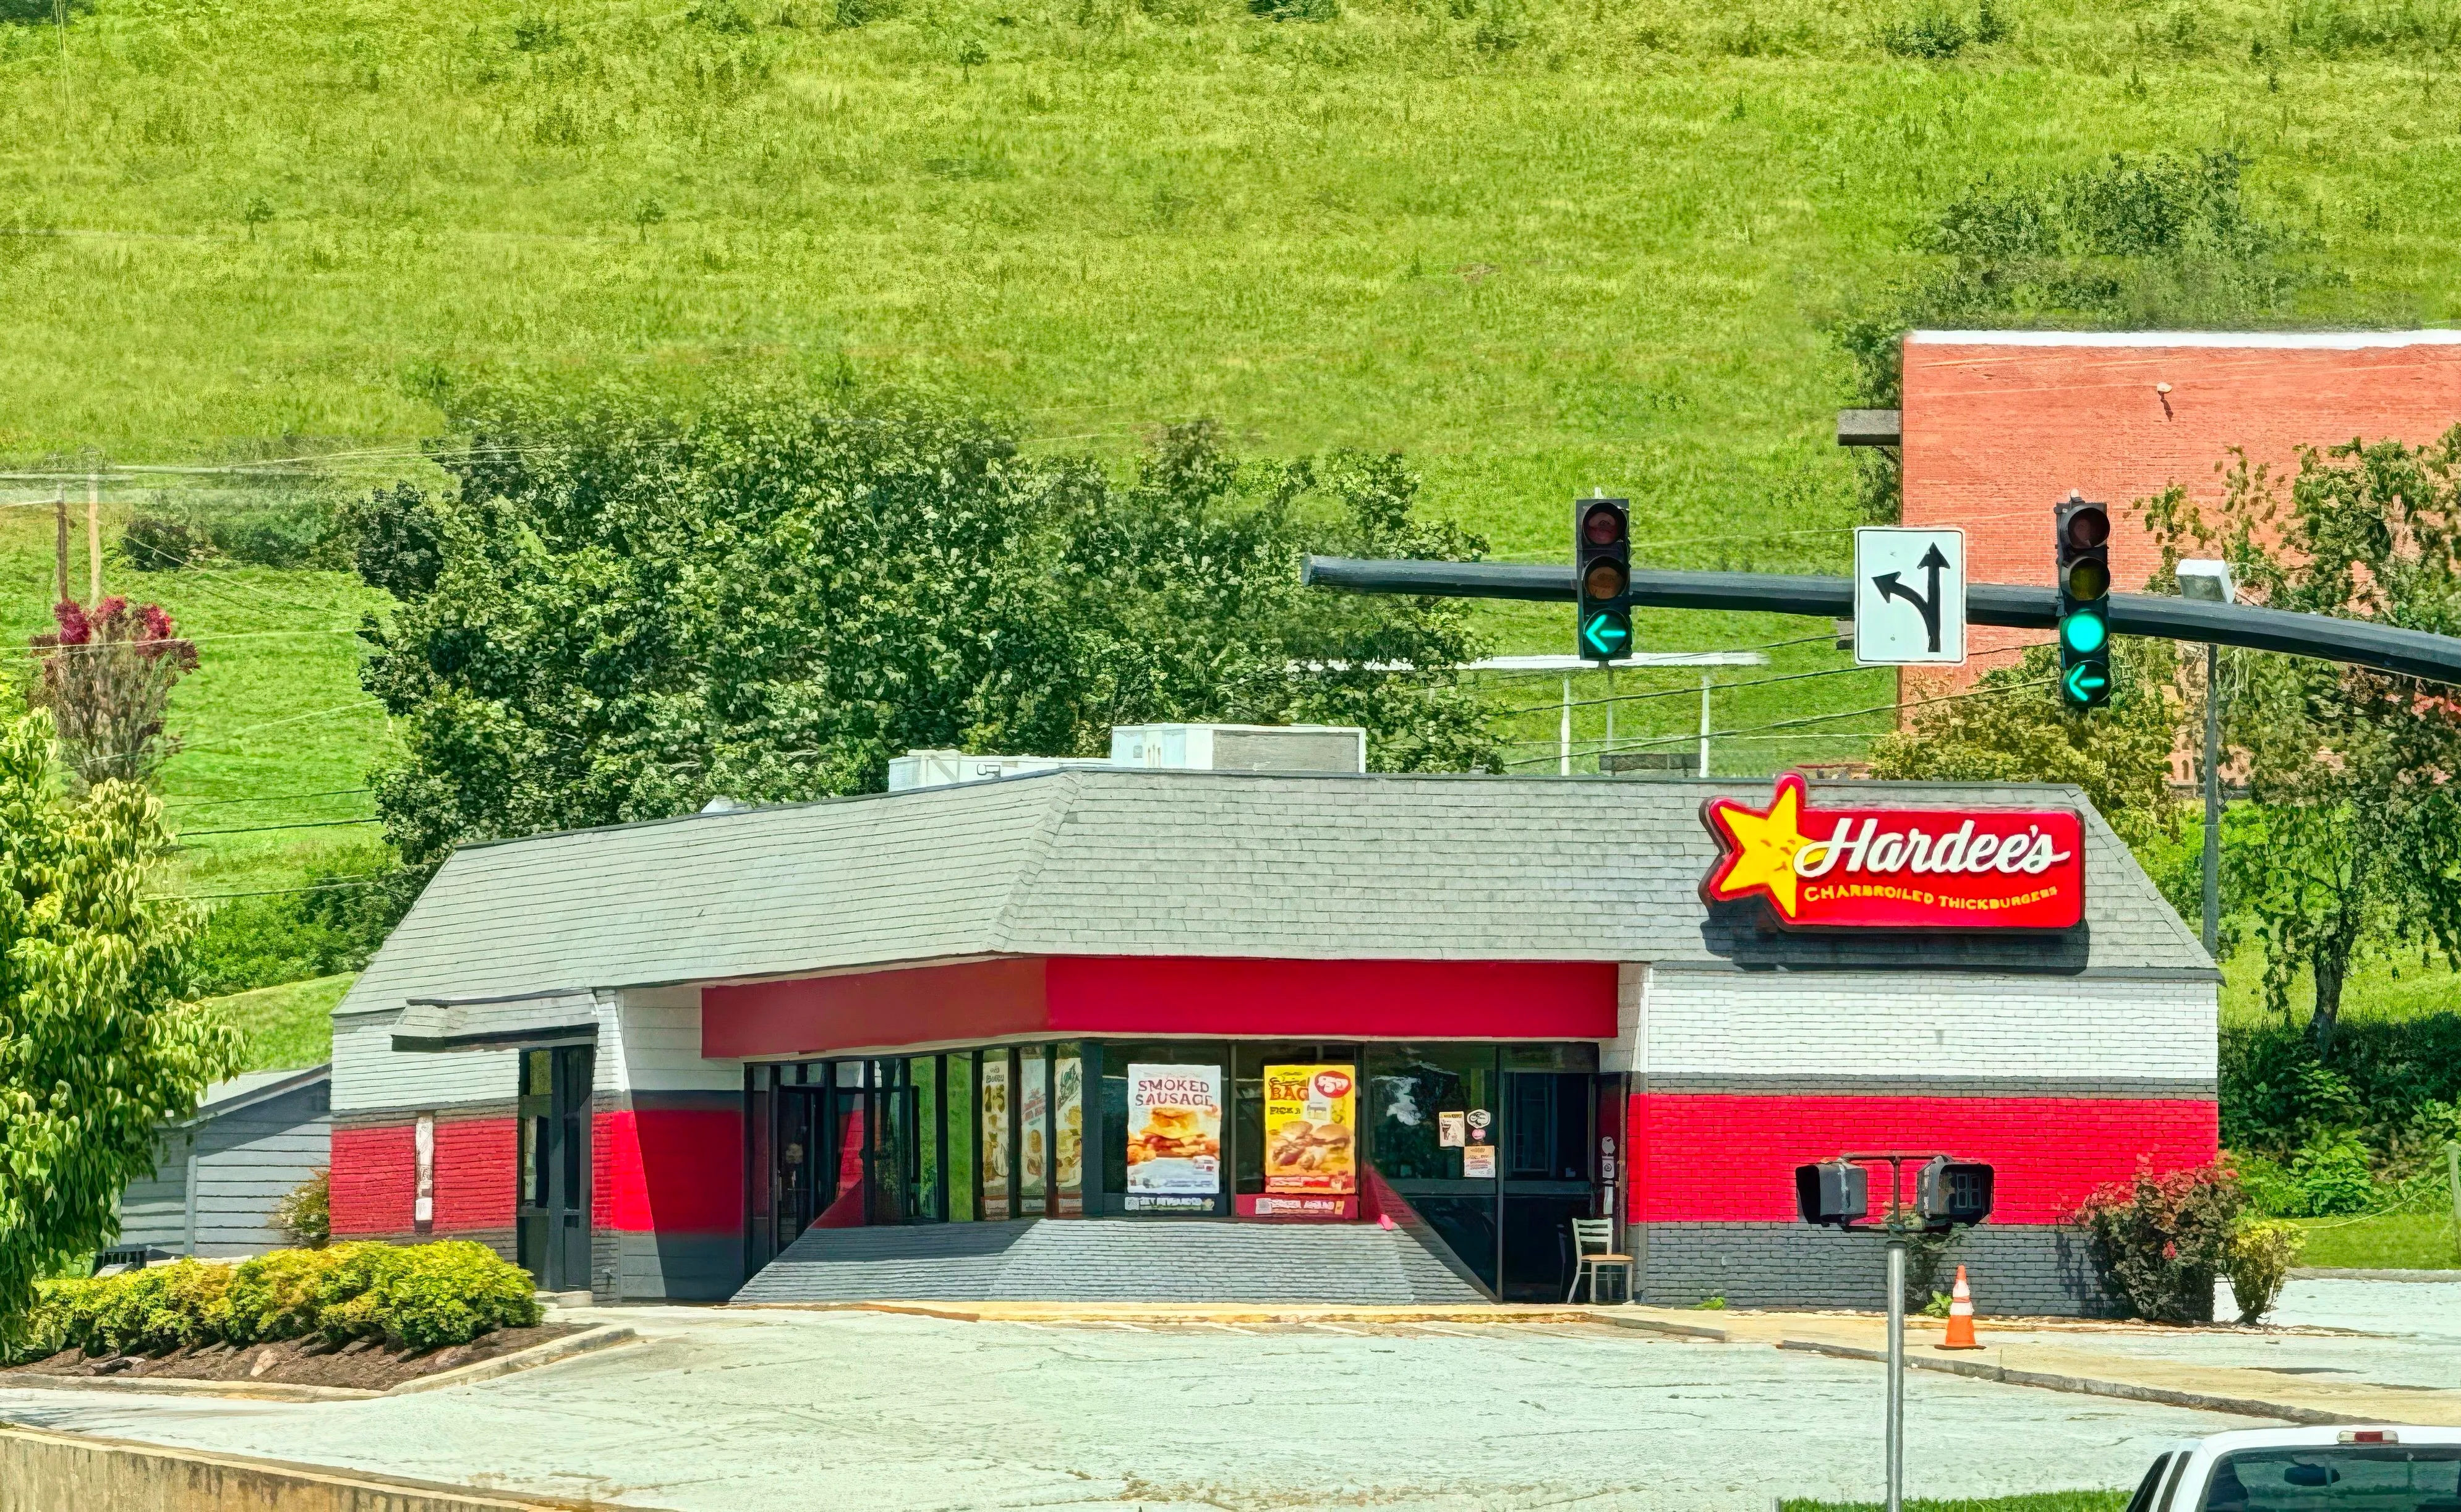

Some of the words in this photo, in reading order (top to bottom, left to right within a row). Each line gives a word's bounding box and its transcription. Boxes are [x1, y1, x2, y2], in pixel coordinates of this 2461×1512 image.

[1793, 817, 2071, 878] Hardee's
[1804, 884, 1935, 905] CHARBROILED
[1938, 886, 2058, 910] THICKBURGERS
[1138, 1079, 1209, 1093] SMOKED
[1135, 1092, 1213, 1106] SAUSAGE
